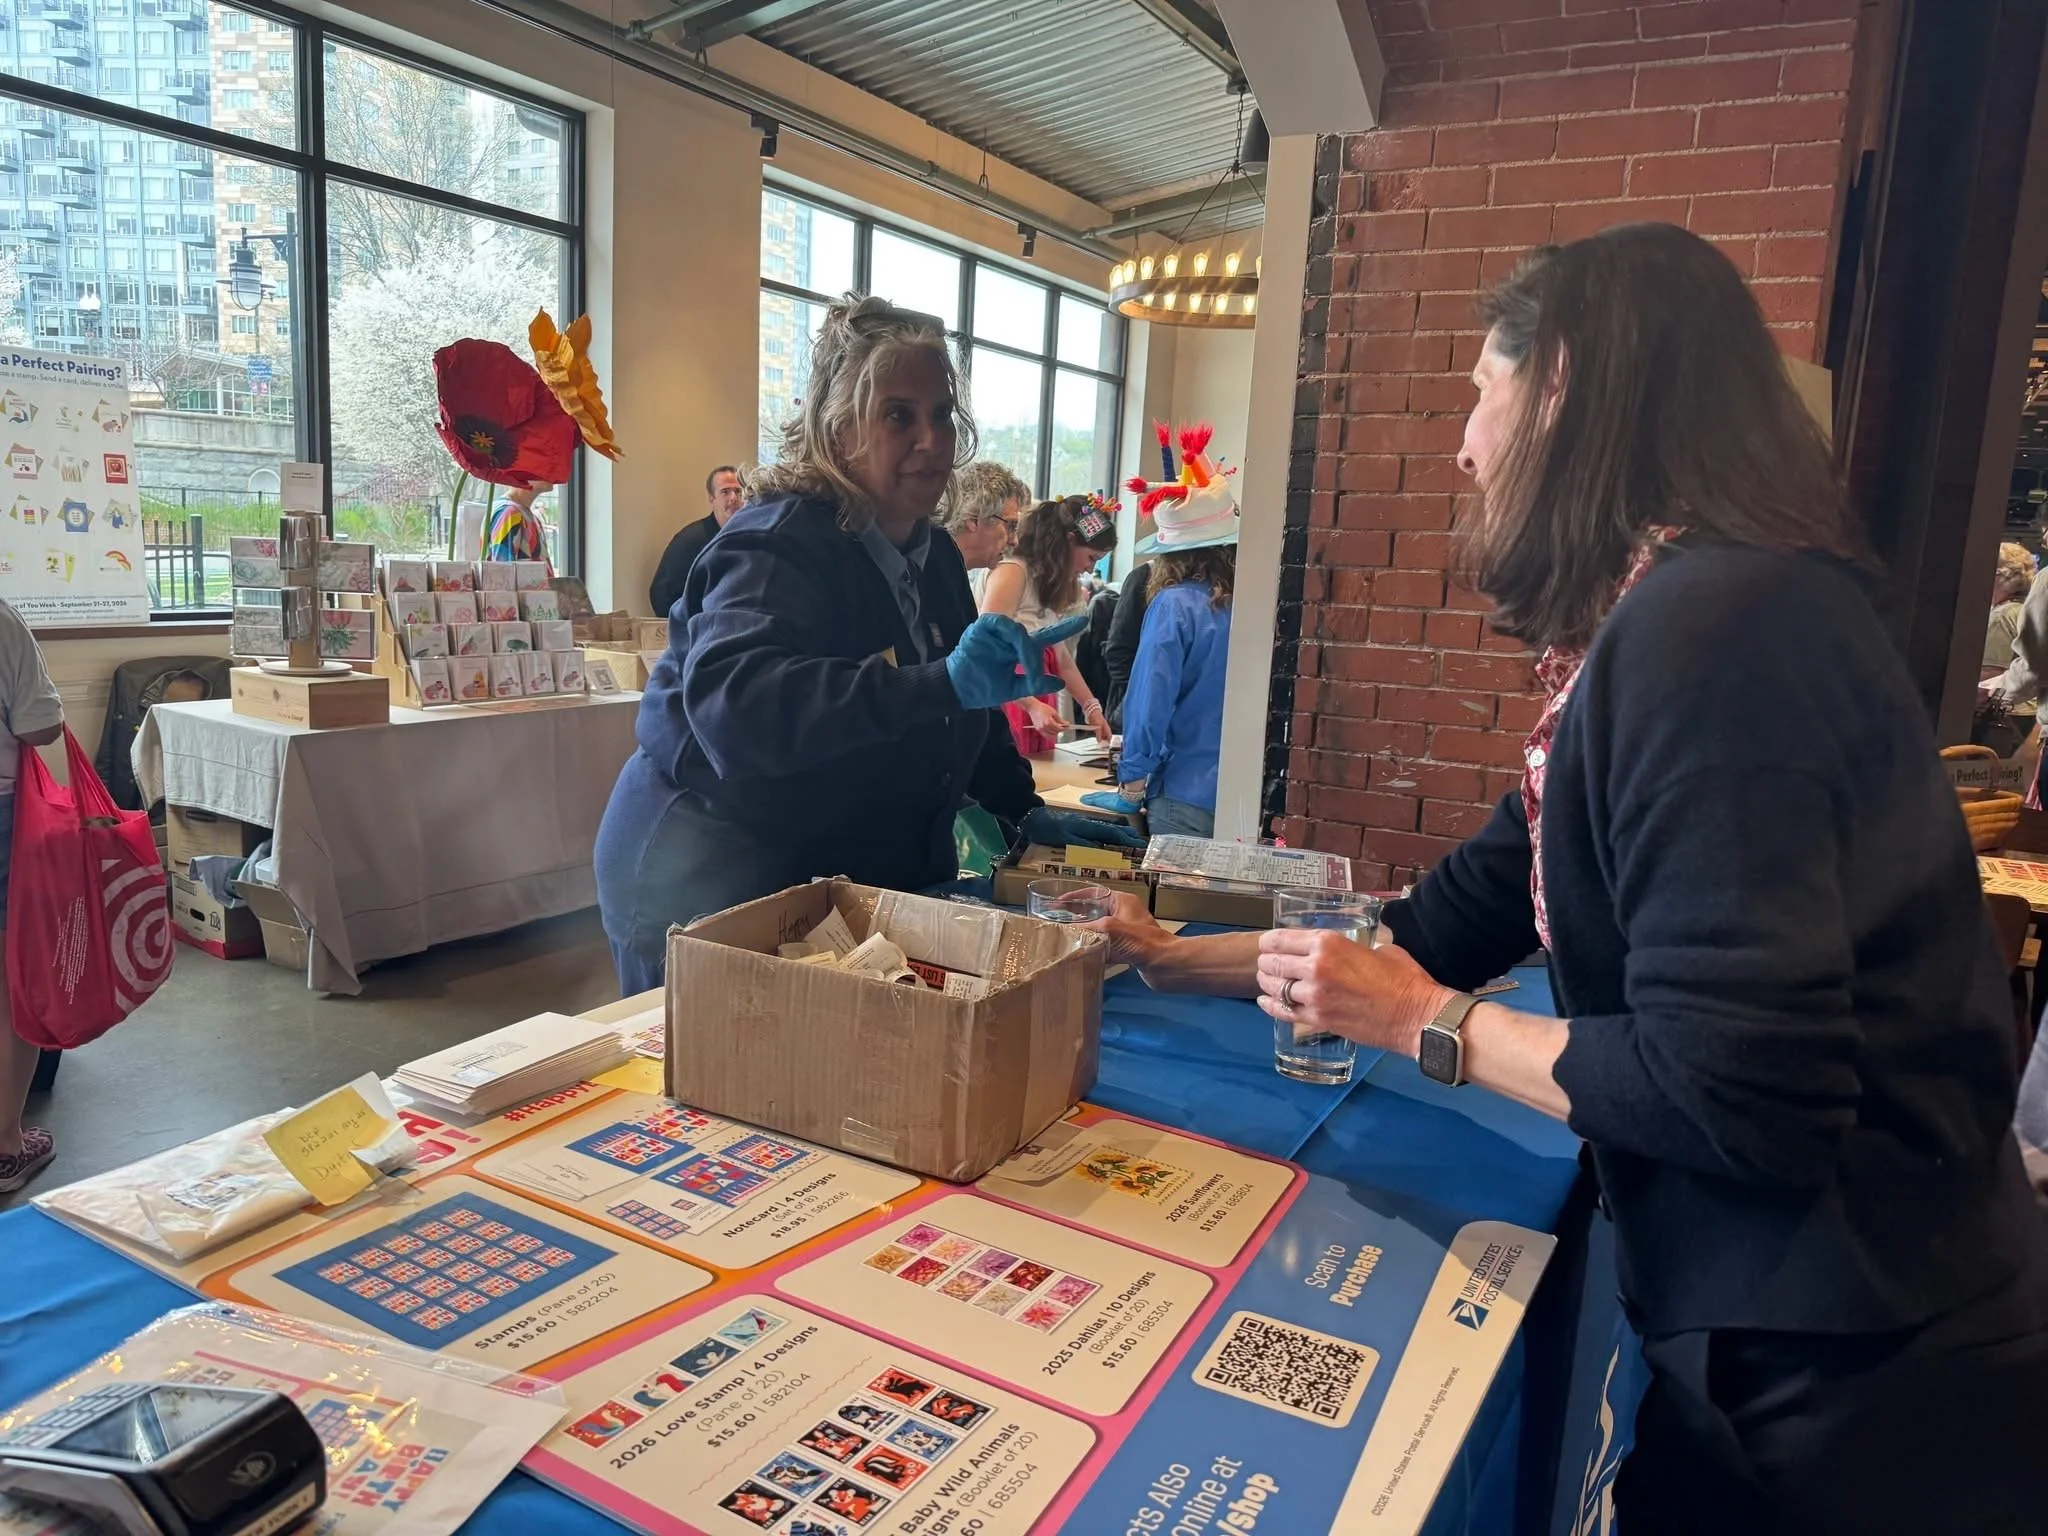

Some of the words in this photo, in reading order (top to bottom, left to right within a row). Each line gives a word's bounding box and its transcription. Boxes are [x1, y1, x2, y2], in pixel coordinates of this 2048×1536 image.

[12, 354, 64, 372] Perfect
[67, 361, 121, 381] Pairing?
[40, 374, 57, 382] Send
[60, 601, 93, 609] September
[1956, 768, 1988, 783] Perfect
[723, 1205, 778, 1239] Notecard
[785, 1194, 795, 1203] 4
[792, 1172, 837, 1197] Designs
[770, 1215, 807, 1239] $18.95
[811, 1190, 849, 1215] 582266
[772, 1207, 796, 1223] (Set
[795, 1200, 807, 1211] of
[1165, 1204, 1190, 1223] 2026
[1183, 1173, 1225, 1206] Sunflowers
[1186, 1197, 1217, 1222] (Booklet
[1212, 1190, 1223, 1199] of
[1199, 1209, 1228, 1232] $15.60
[1225, 1183, 1255, 1207] 685804
[1304, 1259, 1339, 1290] Scan
[1325, 1244, 1347, 1262] to
[1328, 1243, 1384, 1308] purchase
[1460, 1267, 1488, 1298] UNITED
[1477, 1242, 1502, 1272] STATES
[1480, 1277, 1507, 1307] POSTAL
[474, 1314, 537, 1350] Stamps
[537, 1293, 577, 1317] (Pane
[578, 1284, 593, 1296] of
[590, 1272, 617, 1288] 20)
[507, 1320, 558, 1350] $15.60
[566, 1286, 620, 1317] 582204
[1042, 1349, 1074, 1376] 2025
[1068, 1316, 1109, 1351] Dahlias
[1106, 1302, 1124, 1315] 10
[1119, 1271, 1157, 1302] Designs
[1089, 1320, 1128, 1355] (Booklet
[1125, 1310, 1138, 1323] of
[1133, 1299, 1150, 1314] 20)
[1102, 1337, 1138, 1369] $15.60
[1138, 1300, 1175, 1334] 685304
[610, 1436, 657, 1470] 2026
[655, 1409, 698, 1438] Love
[695, 1375, 746, 1411] Stamp
[753, 1360, 767, 1372] 4
[763, 1324, 819, 1363] Designs
[696, 1402, 743, 1433] (Pane
[743, 1388, 760, 1402] of
[760, 1369, 787, 1389] 20)
[707, 1413, 757, 1449] $15.60
[763, 1372, 812, 1408] 582104
[898, 1499, 943, 1534] Baby
[934, 1467, 973, 1498] Wild
[968, 1422, 1021, 1470] Animals
[956, 1460, 1008, 1509] (Booklet
[1004, 1447, 1020, 1463] of
[1015, 1430, 1040, 1450] 20)
[988, 1463, 1040, 1511] 685504
[1148, 1463, 1191, 1509] Also
[1211, 1456, 1243, 1479] at
[1384, 1473, 1401, 1496] United
[1405, 1437, 1420, 1457] Postal
[1216, 1472, 1280, 1536] /shop
